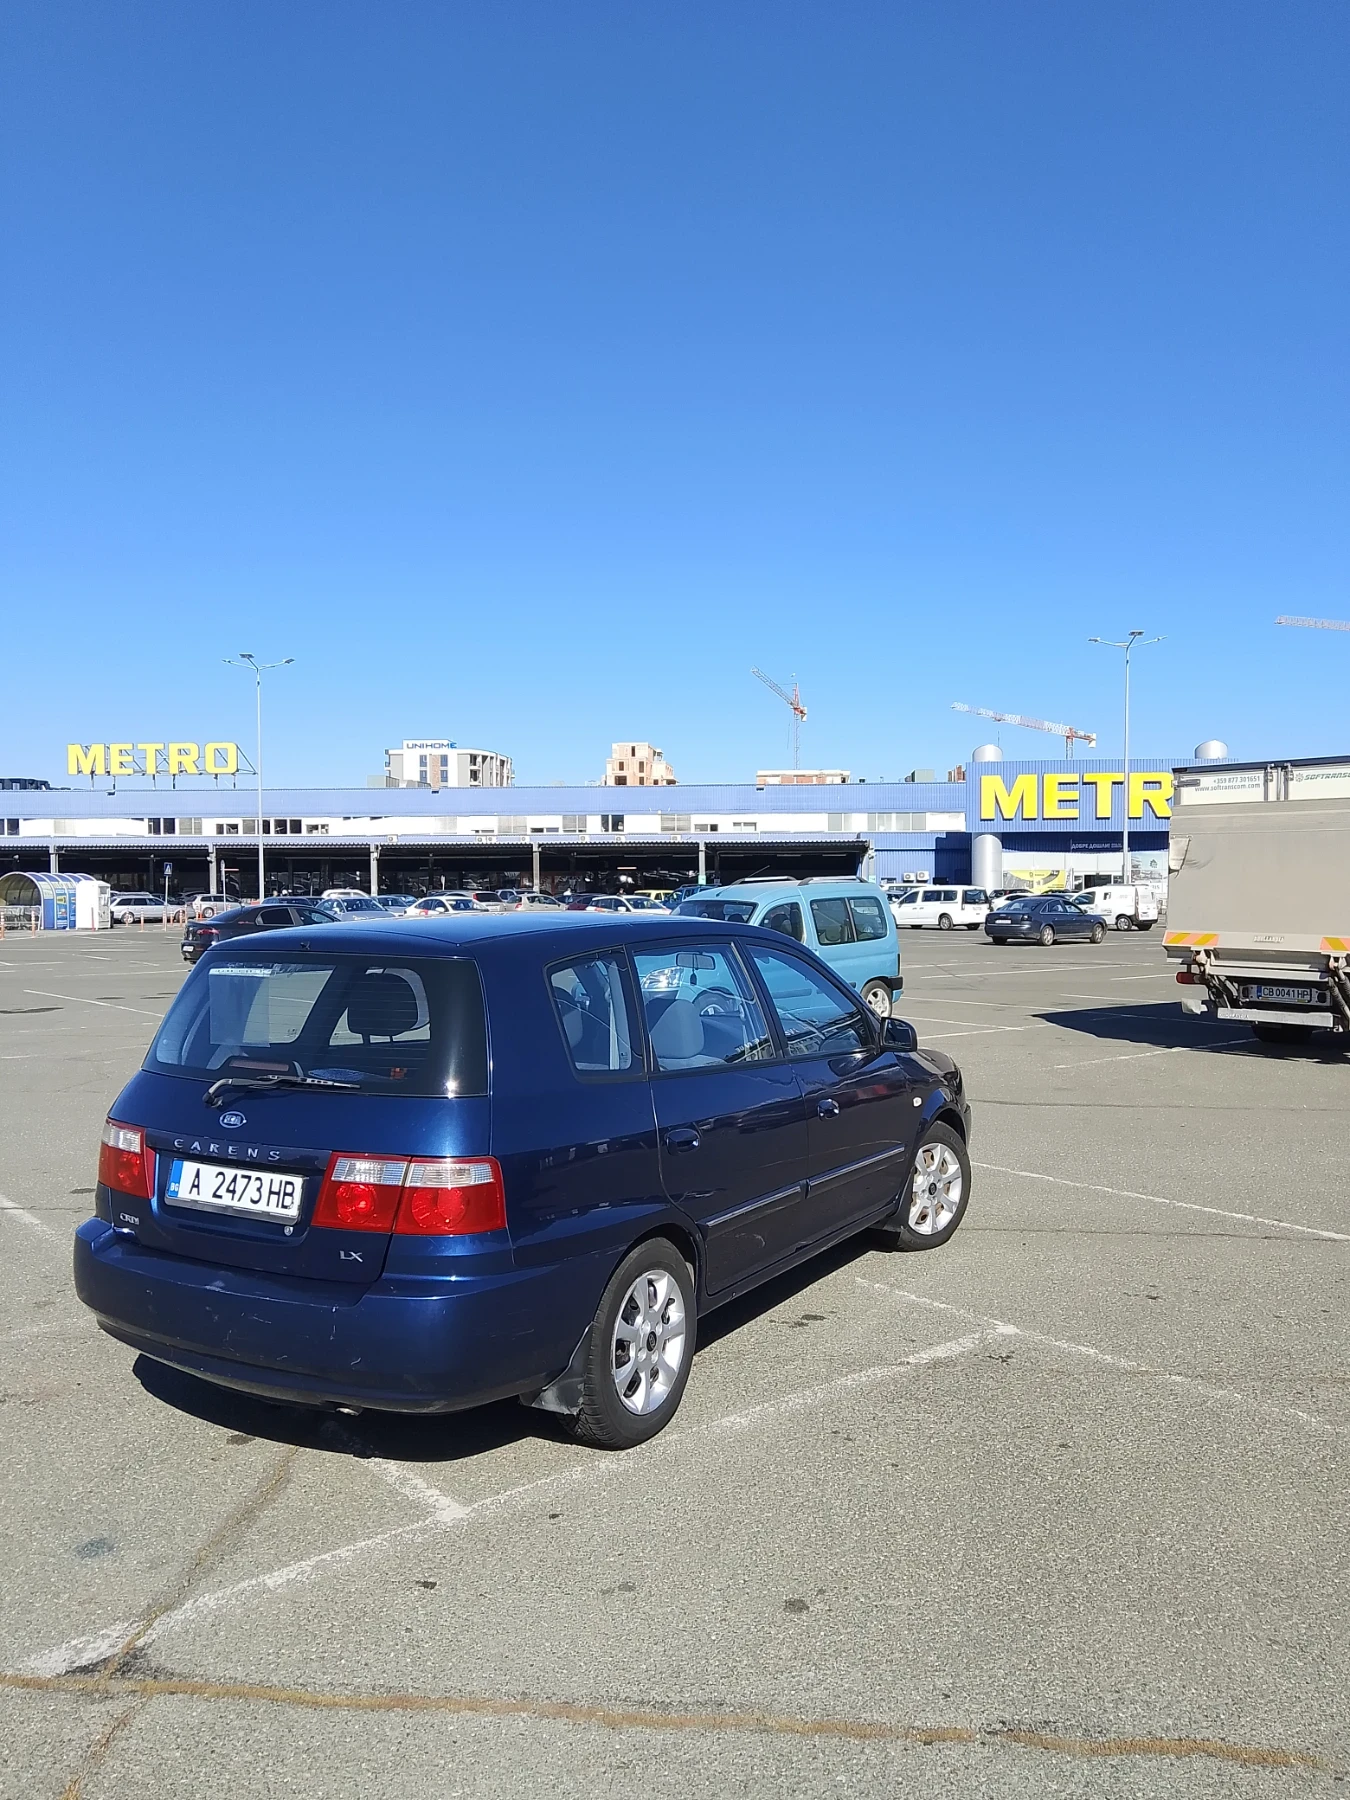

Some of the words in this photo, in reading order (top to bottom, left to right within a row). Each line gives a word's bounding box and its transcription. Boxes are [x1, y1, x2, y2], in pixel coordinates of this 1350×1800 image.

[67, 742, 238, 775] METRO
[980, 772, 1175, 820] METR
[174, 1138, 280, 1161] CARENS
[170, 1182, 179, 1192] BG
[339, 1250, 363, 1263] LX
